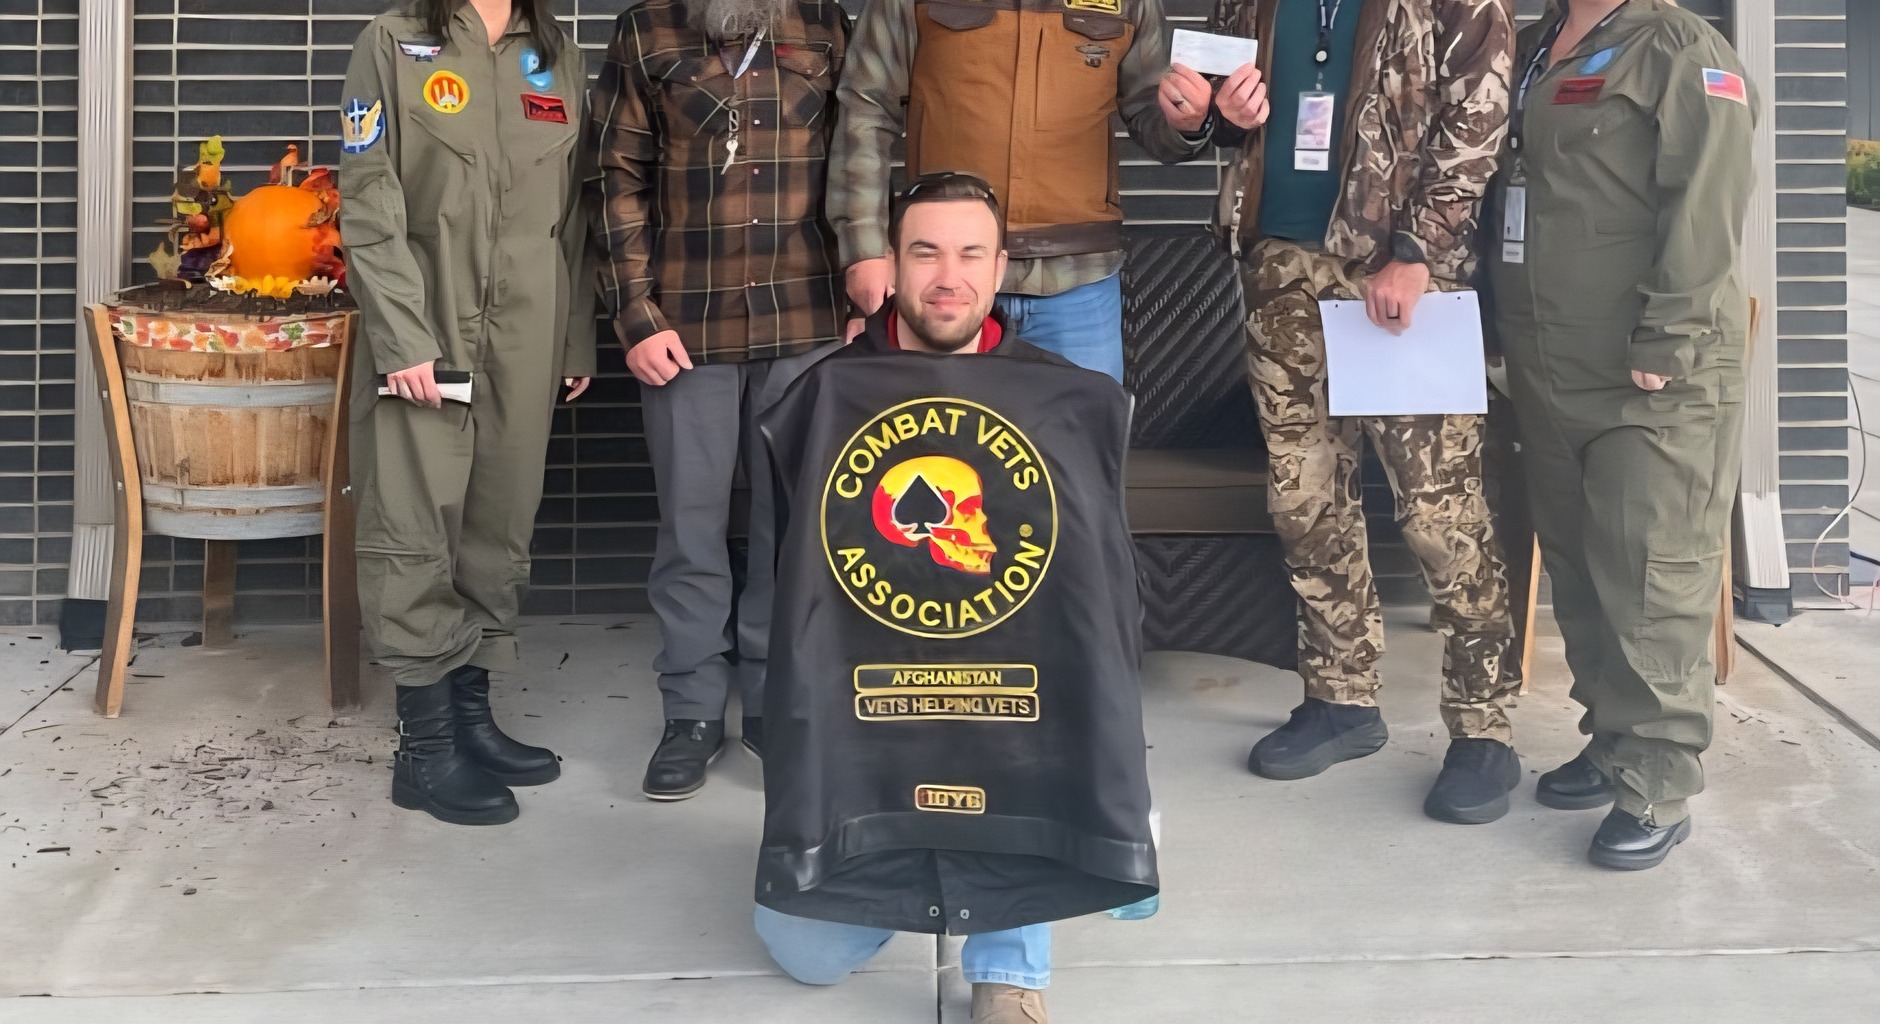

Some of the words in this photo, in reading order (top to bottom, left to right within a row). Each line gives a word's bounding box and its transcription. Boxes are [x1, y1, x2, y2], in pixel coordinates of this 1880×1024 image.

[836, 408, 967, 499] COMBAT
[977, 415, 1039, 490] VETS
[838, 540, 1046, 628] ASSOCIATION
[892, 670, 1002, 686] AFGHANISTAN
[865, 698, 908, 714] VETS
[986, 698, 1031, 714] VETS
